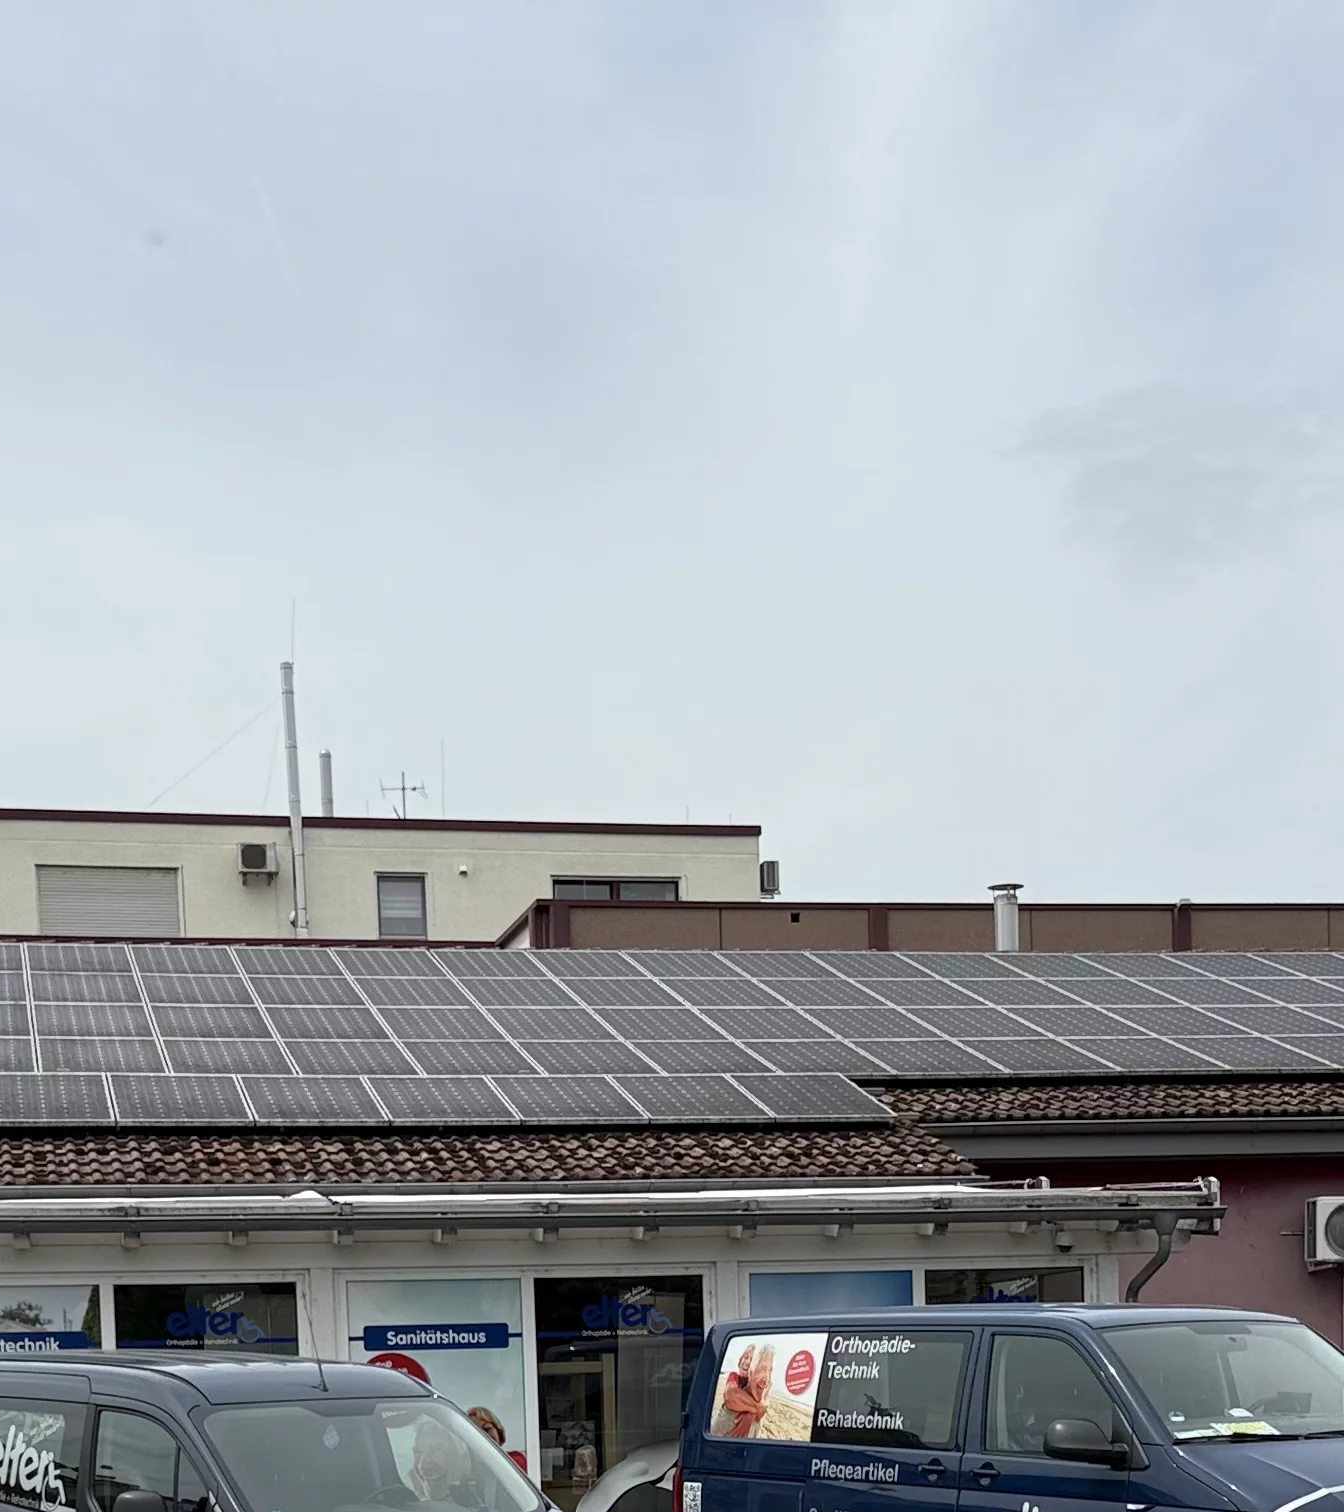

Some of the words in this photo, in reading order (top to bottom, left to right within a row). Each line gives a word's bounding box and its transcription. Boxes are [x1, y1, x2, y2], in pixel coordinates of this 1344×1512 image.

[167, 1302, 243, 1336] elter
[582, 1296, 654, 1328] elter
[387, 1330, 486, 1346] Sanitätshaus
[832, 1336, 916, 1357] Orthopädie-
[828, 1362, 880, 1379] Technik
[817, 1410, 904, 1430] Rehatechnik
[811, 1459, 899, 1482] Pflegeartikel
